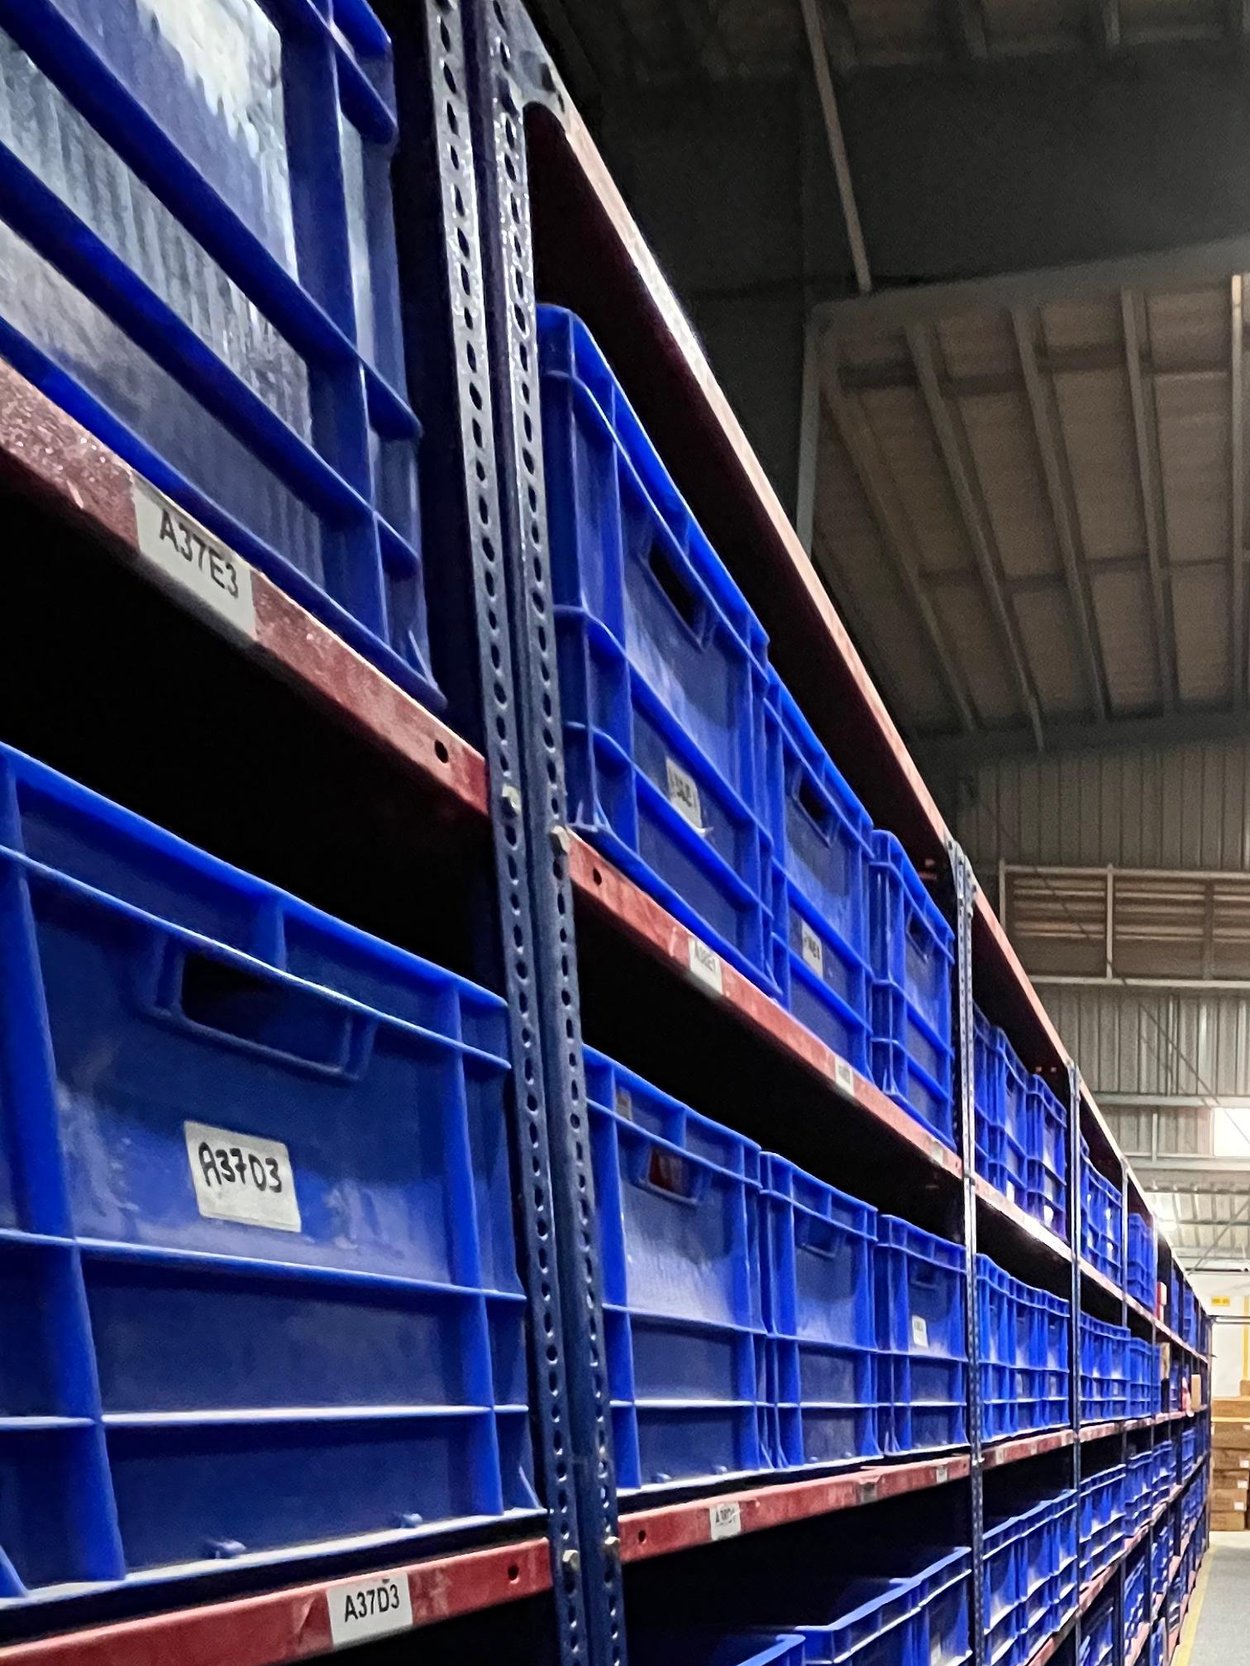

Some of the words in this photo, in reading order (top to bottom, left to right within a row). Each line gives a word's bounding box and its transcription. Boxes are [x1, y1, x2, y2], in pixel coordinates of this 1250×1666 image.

[160, 508, 239, 599] A37E3
[198, 1141, 282, 1193] A37D3
[344, 1583, 400, 1623] A37D3
